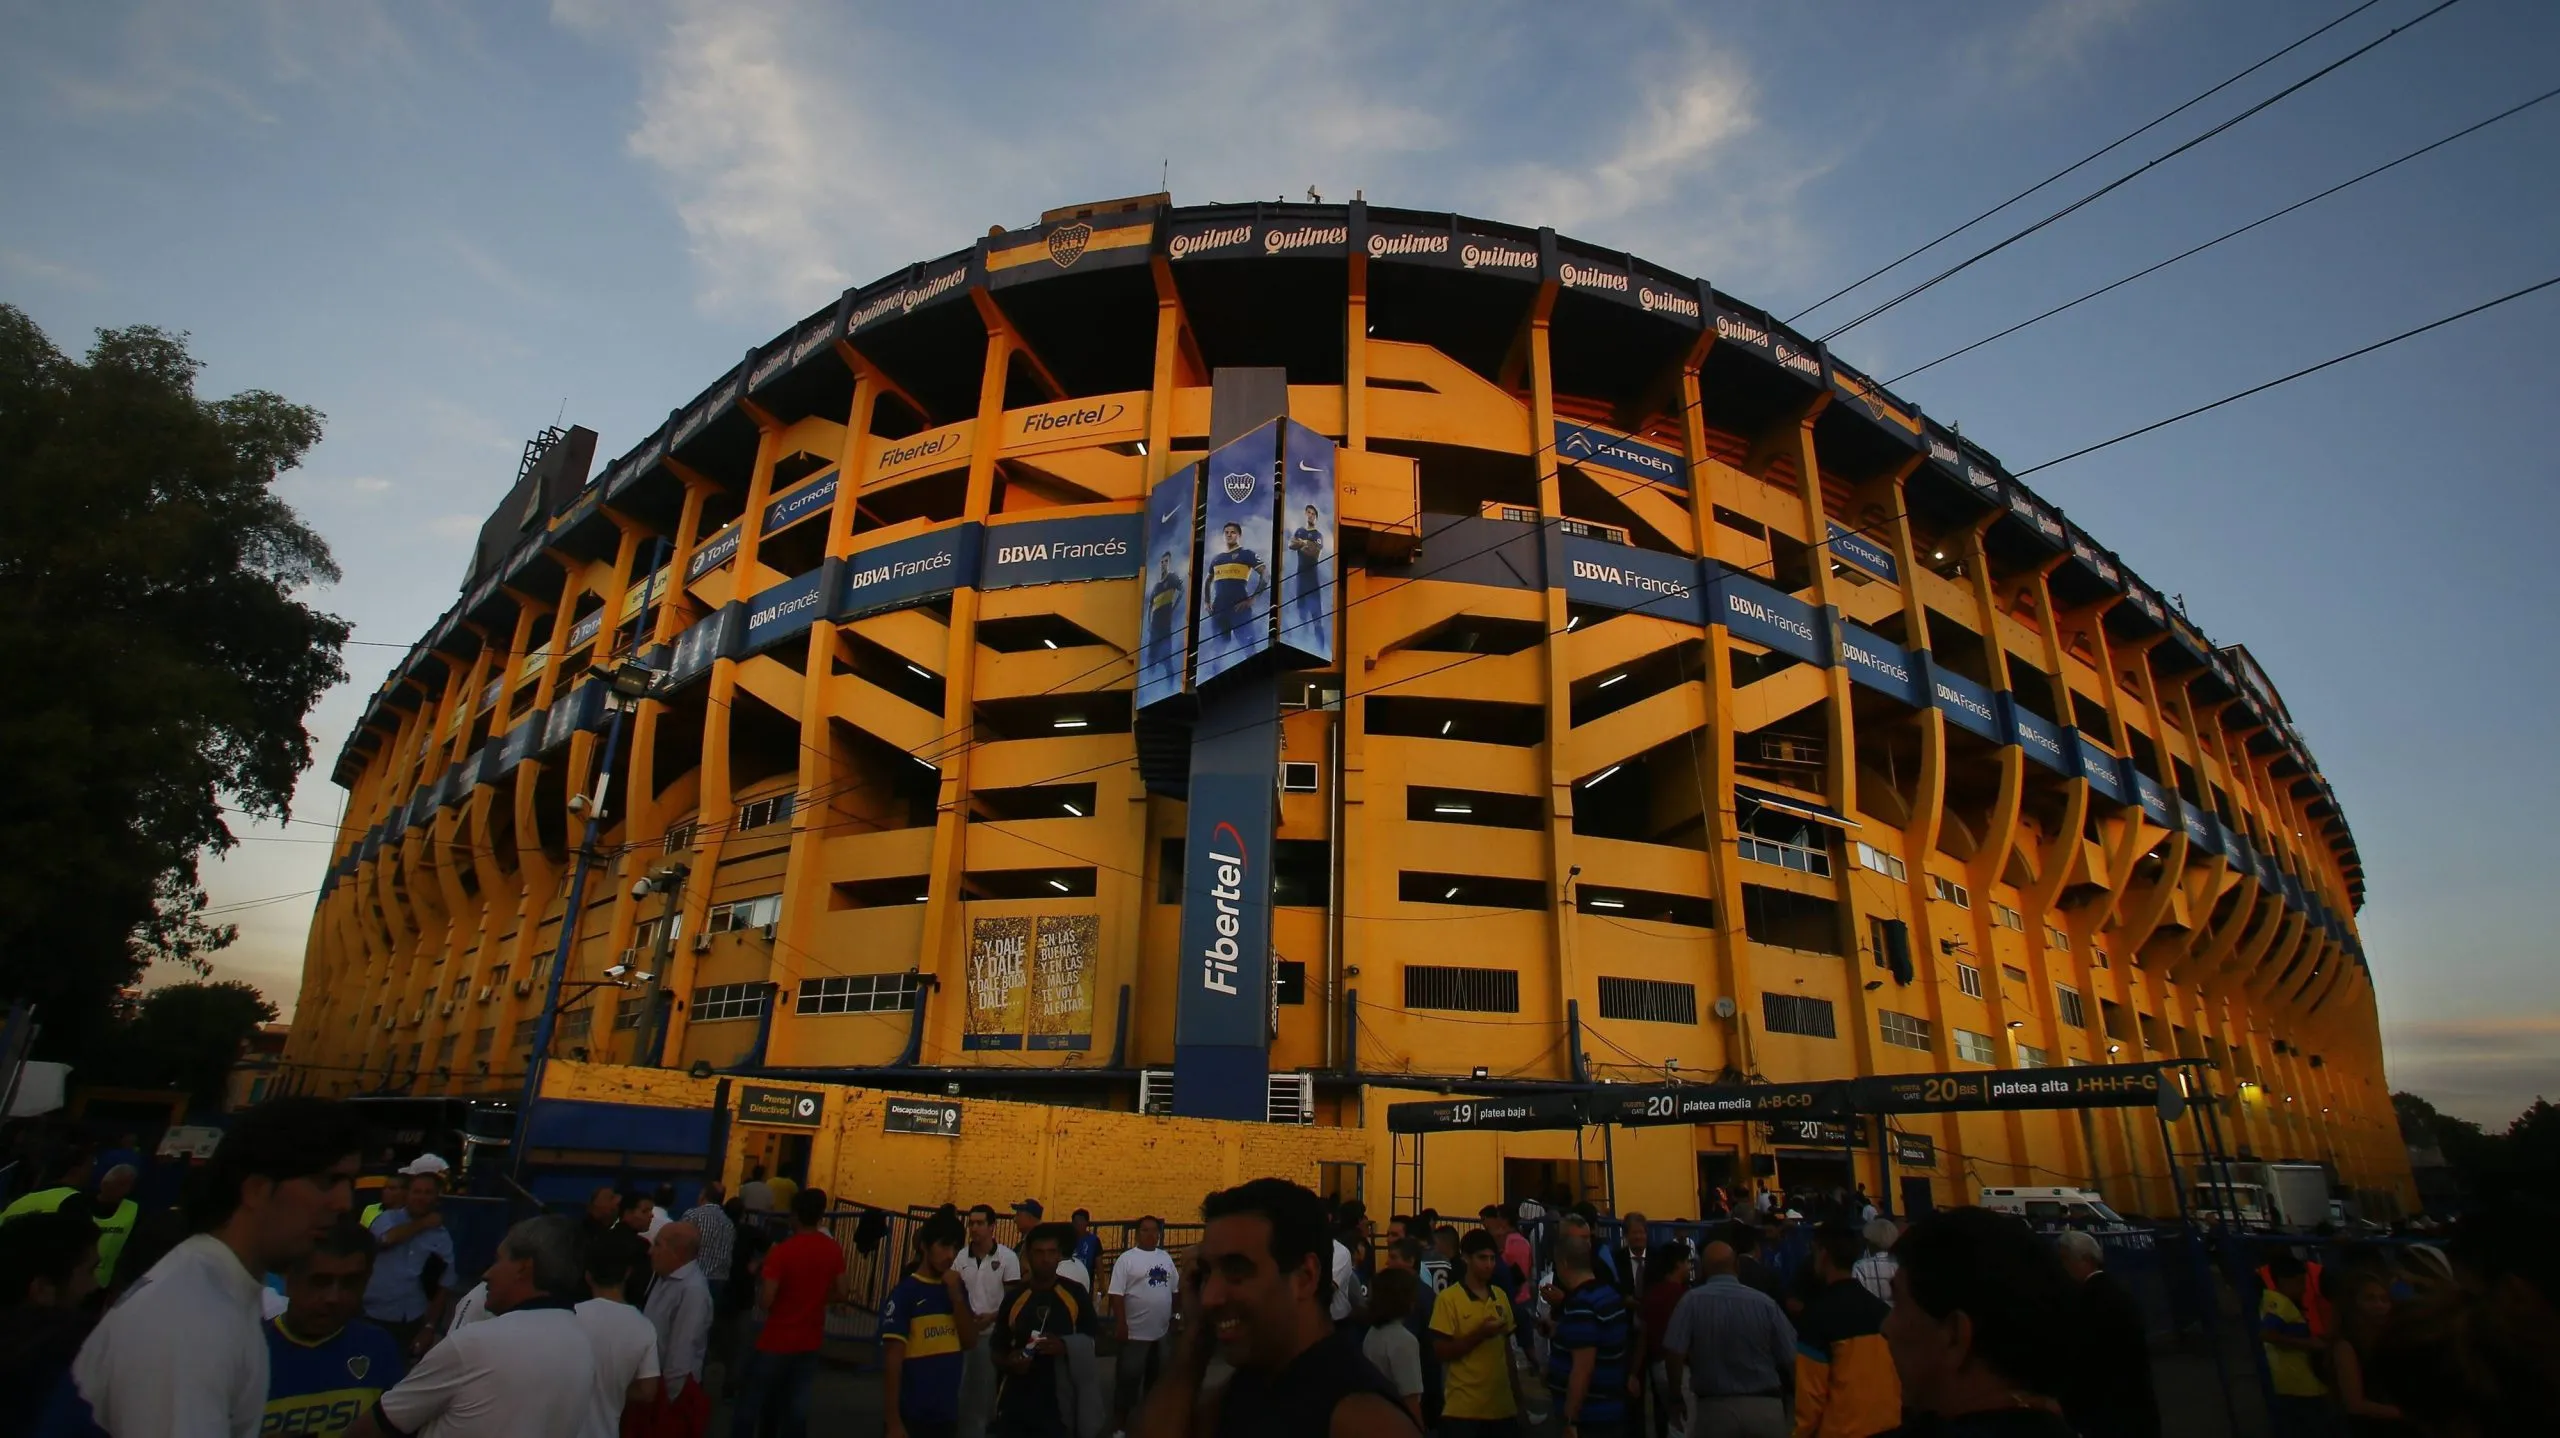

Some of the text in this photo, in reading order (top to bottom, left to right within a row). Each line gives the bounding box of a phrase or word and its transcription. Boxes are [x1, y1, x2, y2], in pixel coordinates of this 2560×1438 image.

[1169, 224, 1253, 260] Quilmes
[1264, 226, 1348, 255] Quilmes
[1367, 234, 1449, 258] Quilmes
[1461, 244, 1538, 269] Quilmes
[903, 266, 967, 313] Quilmes
[1560, 264, 1628, 292] Quilmes
[848, 286, 904, 335] Quilmes
[1639, 287, 1699, 317] Quilmes
[1716, 315, 1769, 348] Quilmes
[1775, 344, 1820, 377] Quilmes
[1023, 404, 1106, 433] Fibertel
[879, 434, 946, 469] Fibertel
[1228, 482, 1251, 490] CABJ
[708, 534, 741, 562] TOTAL
[998, 538, 1126, 564] BBVA Francés
[853, 551, 951, 590] BBVA Francés
[1573, 560, 1689, 599] BBVA Francés
[749, 589, 819, 630] BBVA Francés
[1730, 595, 1812, 641] BBVA Francés
[1842, 642, 1909, 683] BBVA Francés
[1960, 693, 1992, 720] Francés
[1204, 852, 1241, 995] Fibertel
[985, 936, 1025, 957] Y DALE
[1043, 930, 1075, 947] EN LAS
[988, 952, 1024, 978] DALE
[1050, 960, 1061, 972] EN
[1065, 956, 1083, 970] LAS
[977, 977, 1000, 992] DALE
[1002, 973, 1027, 989] BOCA
[1047, 971, 1079, 988] MALAS
[763, 1094, 791, 1104] Prensa
[1923, 1078, 1958, 1102] 20
[1959, 1085, 1978, 1095] BIS
[1993, 1081, 2037, 1097] platea
[2041, 1079, 2068, 1092] alta
[750, 1103, 790, 1115] Directivos
[891, 1105, 939, 1116] Discapacitados
[1452, 1104, 1471, 1123] 19
[1480, 1107, 1505, 1120] platea
[1507, 1106, 1526, 1119] baja
[1647, 1094, 1812, 1116] 20 platea media A-B-C-D
[916, 1115, 938, 1124] Prensa
[1800, 1121, 1818, 1139] 20
[261, 1399, 362, 1436] PEPSI
